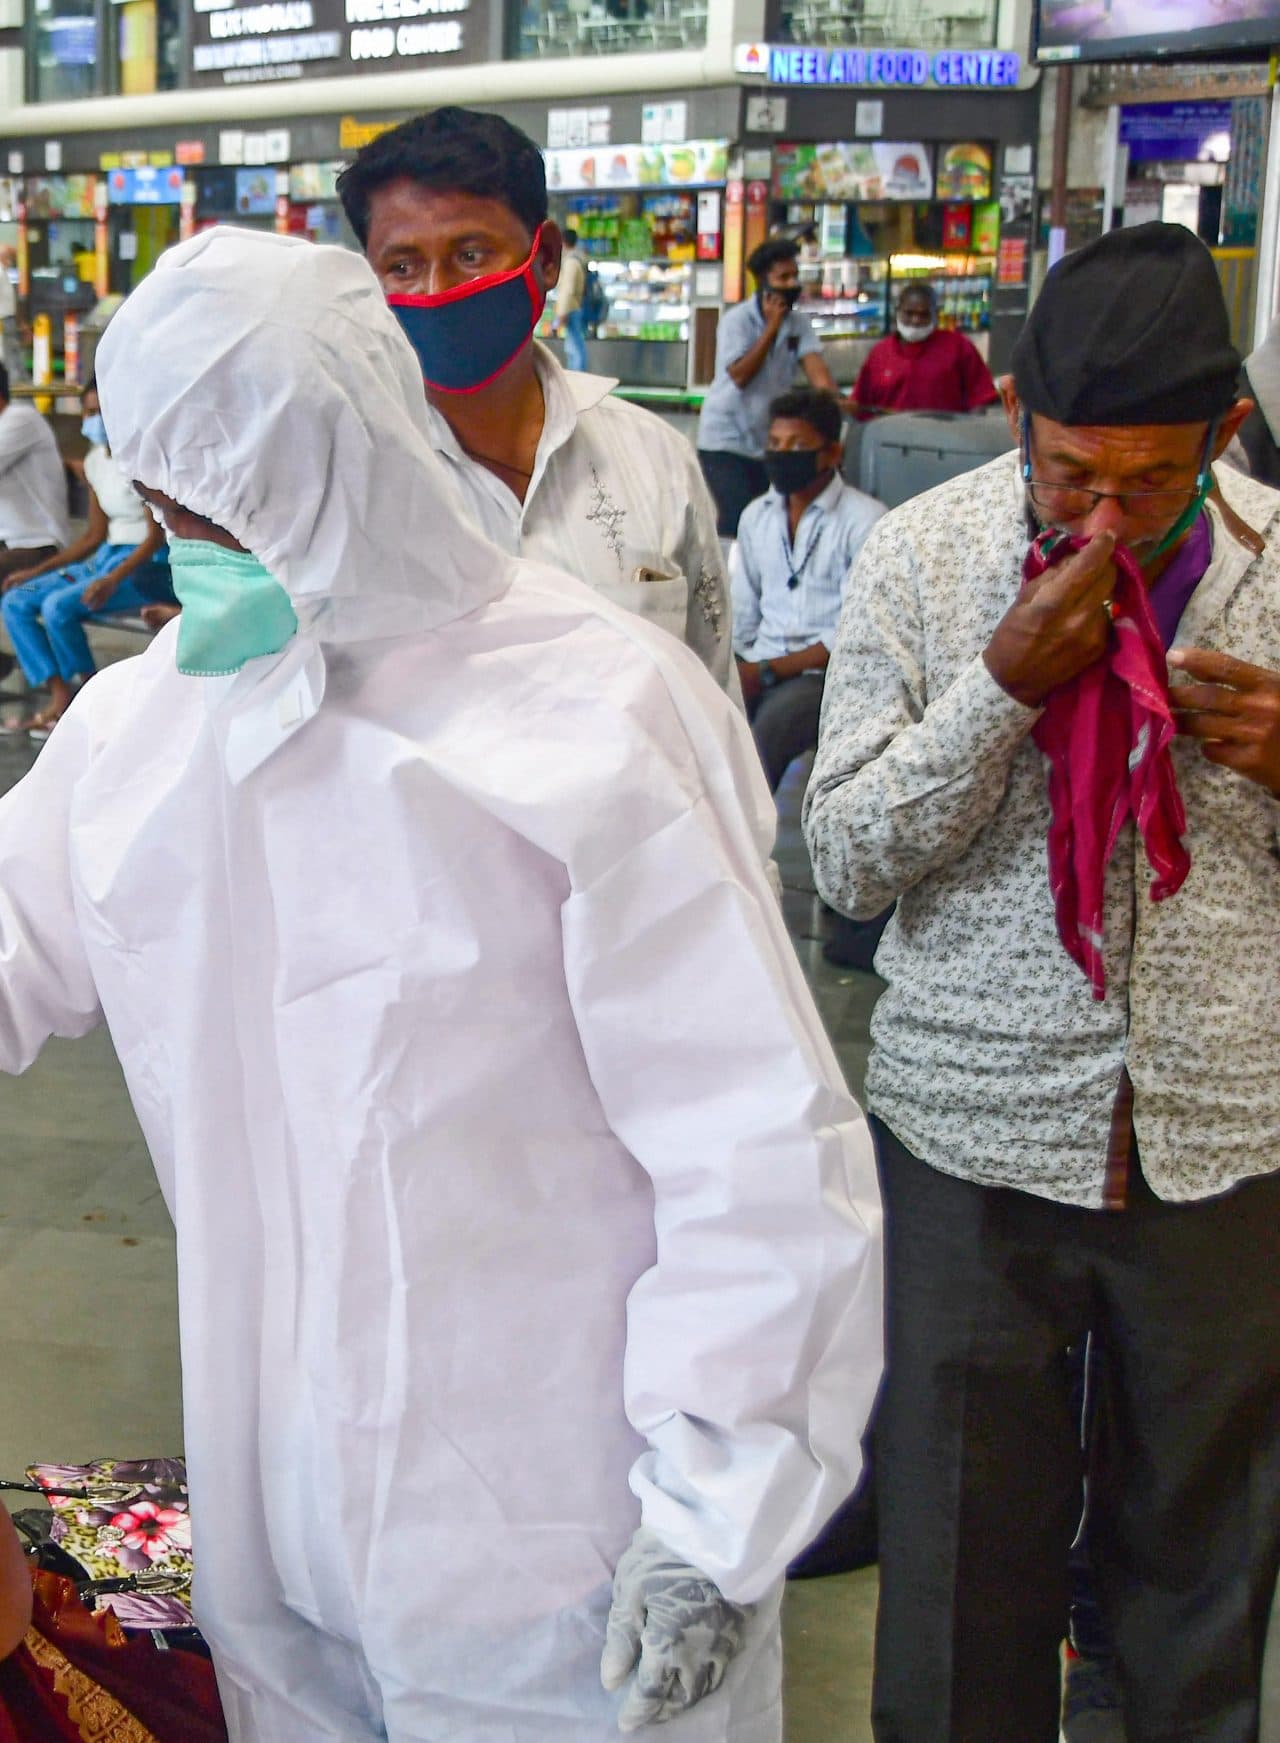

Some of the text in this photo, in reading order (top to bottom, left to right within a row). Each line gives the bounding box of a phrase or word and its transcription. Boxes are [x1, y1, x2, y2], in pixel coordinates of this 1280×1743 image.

[772, 49, 1020, 86] NEELAM FOOD CENTER
